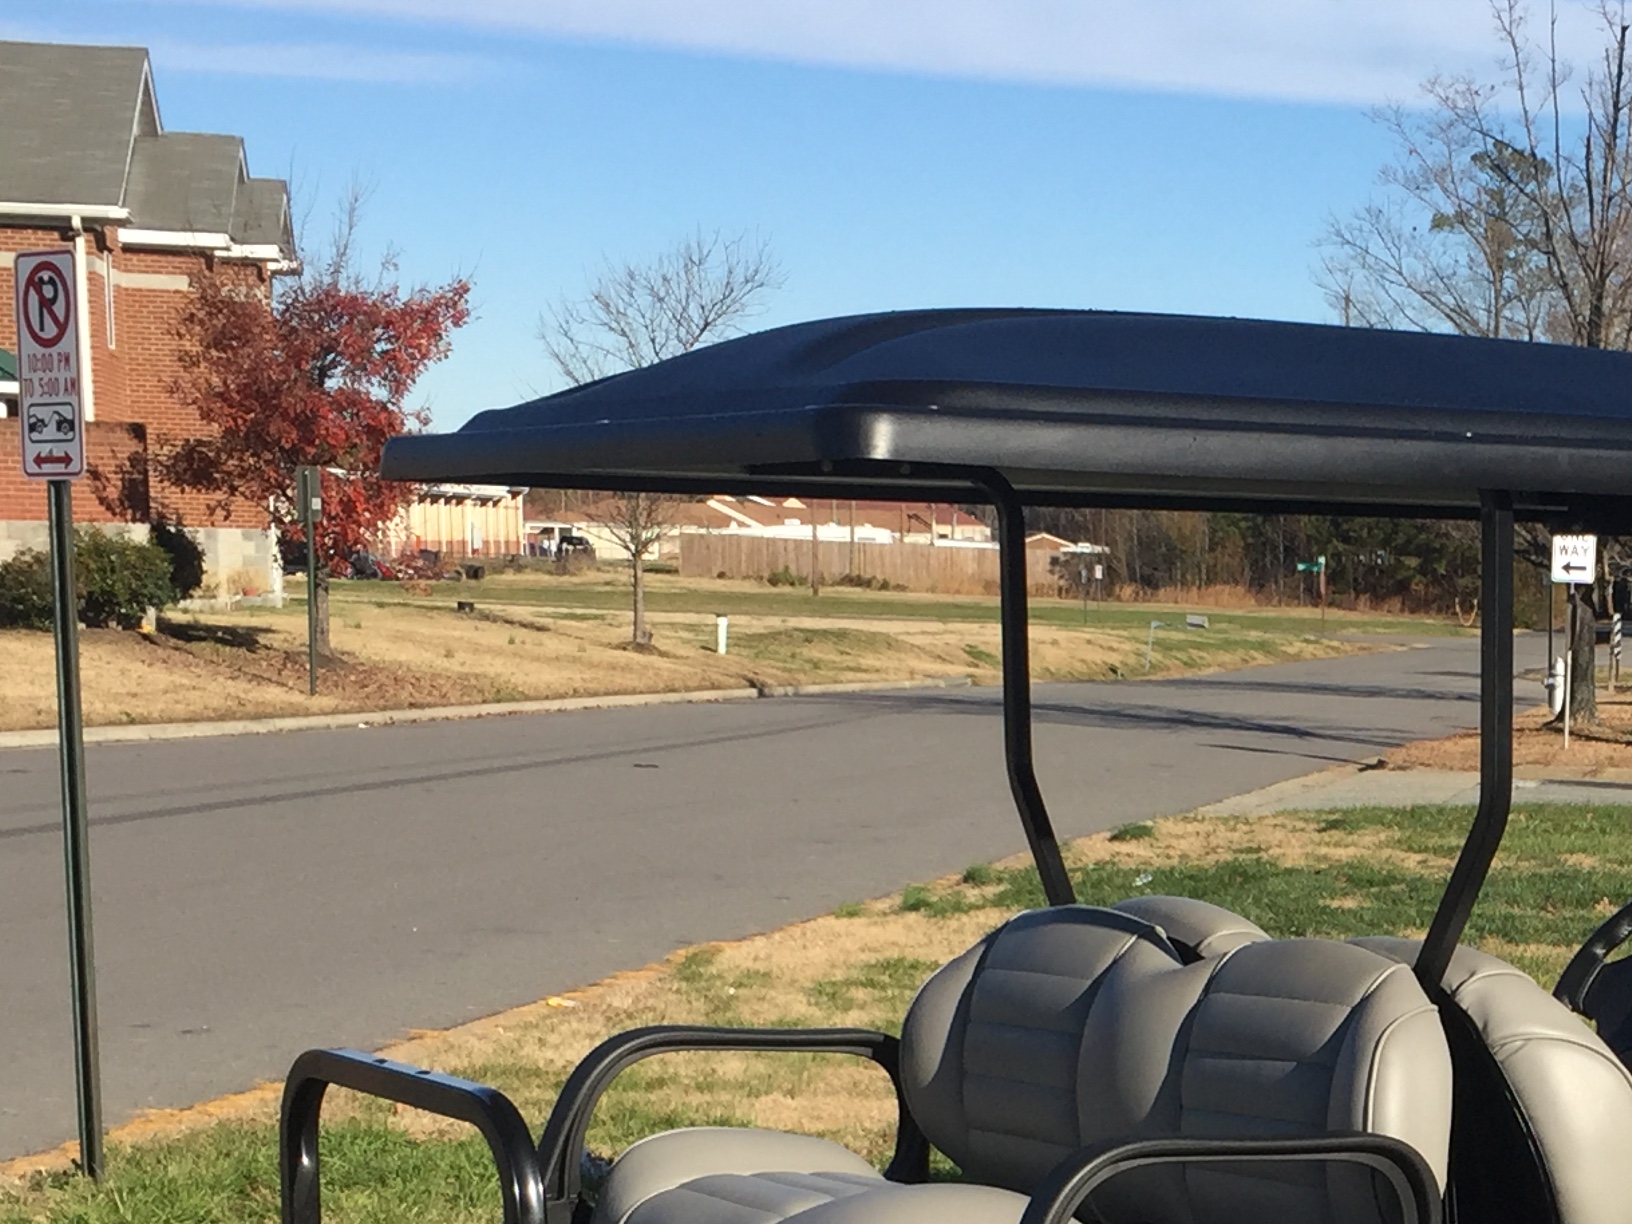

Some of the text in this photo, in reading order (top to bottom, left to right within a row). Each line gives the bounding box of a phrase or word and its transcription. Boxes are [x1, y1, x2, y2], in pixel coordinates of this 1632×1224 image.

[28, 352, 71, 373] 10:00 PM
[23, 376, 78, 398] TO 5:00 AM
[1559, 544, 1590, 557] WAY
